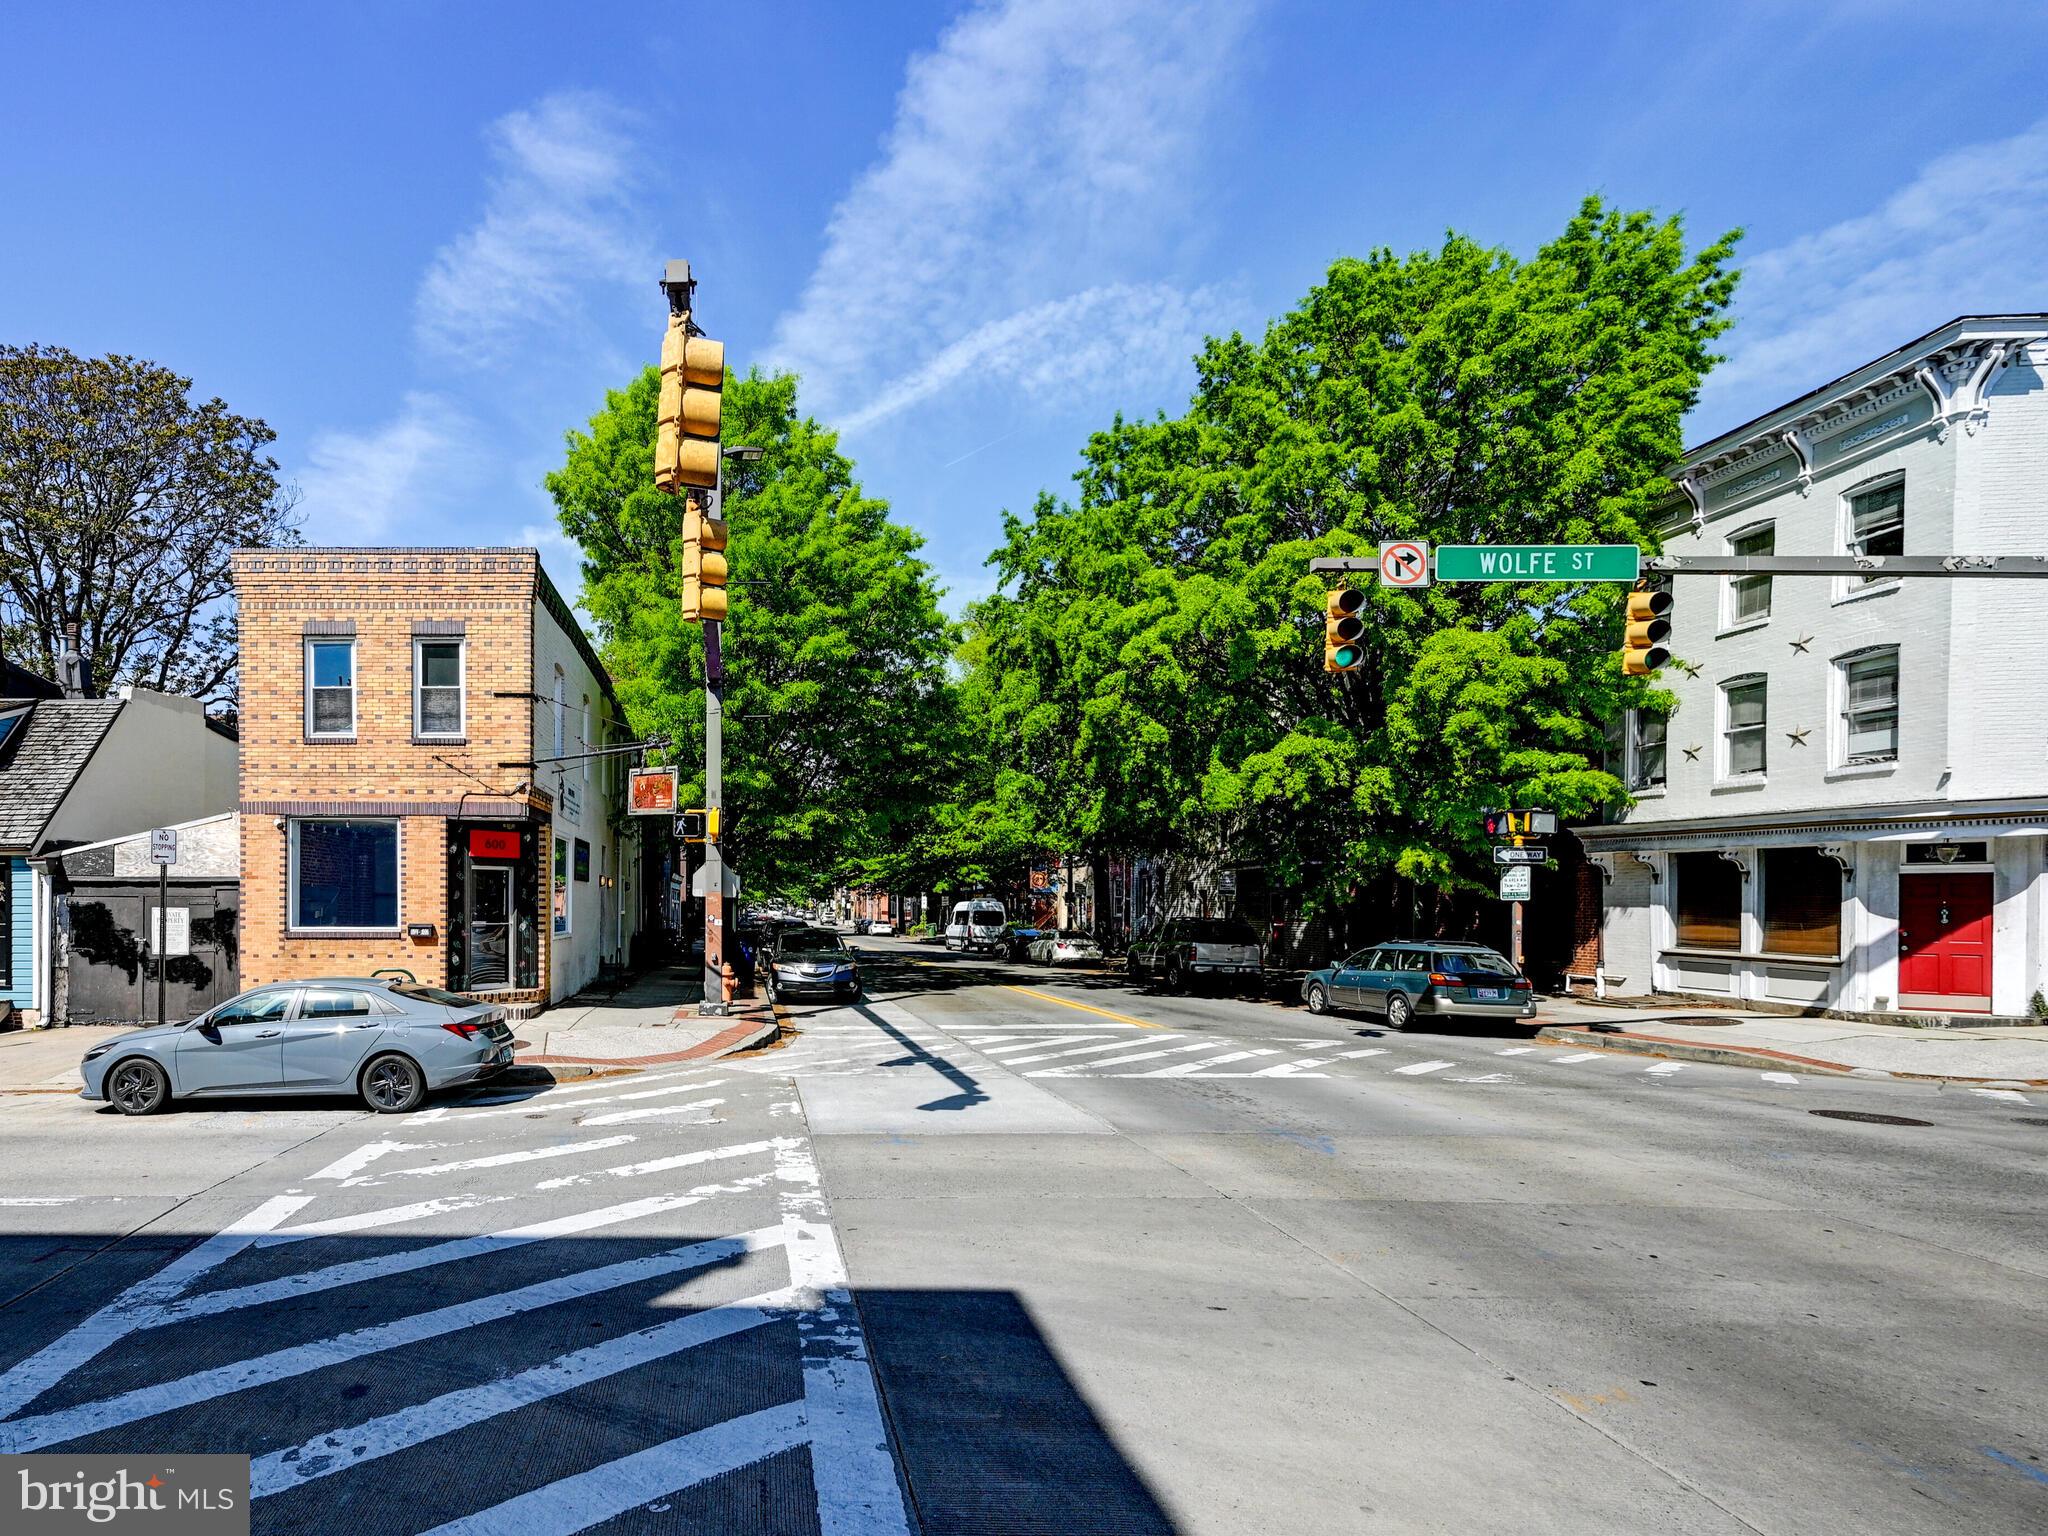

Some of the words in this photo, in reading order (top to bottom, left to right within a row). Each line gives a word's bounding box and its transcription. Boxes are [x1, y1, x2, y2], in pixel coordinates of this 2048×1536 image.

[1480, 552, 1556, 574] WOLFE
[1572, 552, 1594, 570] ST
[152, 843, 176, 851] STOPPING
[484, 839, 506, 850] 600
